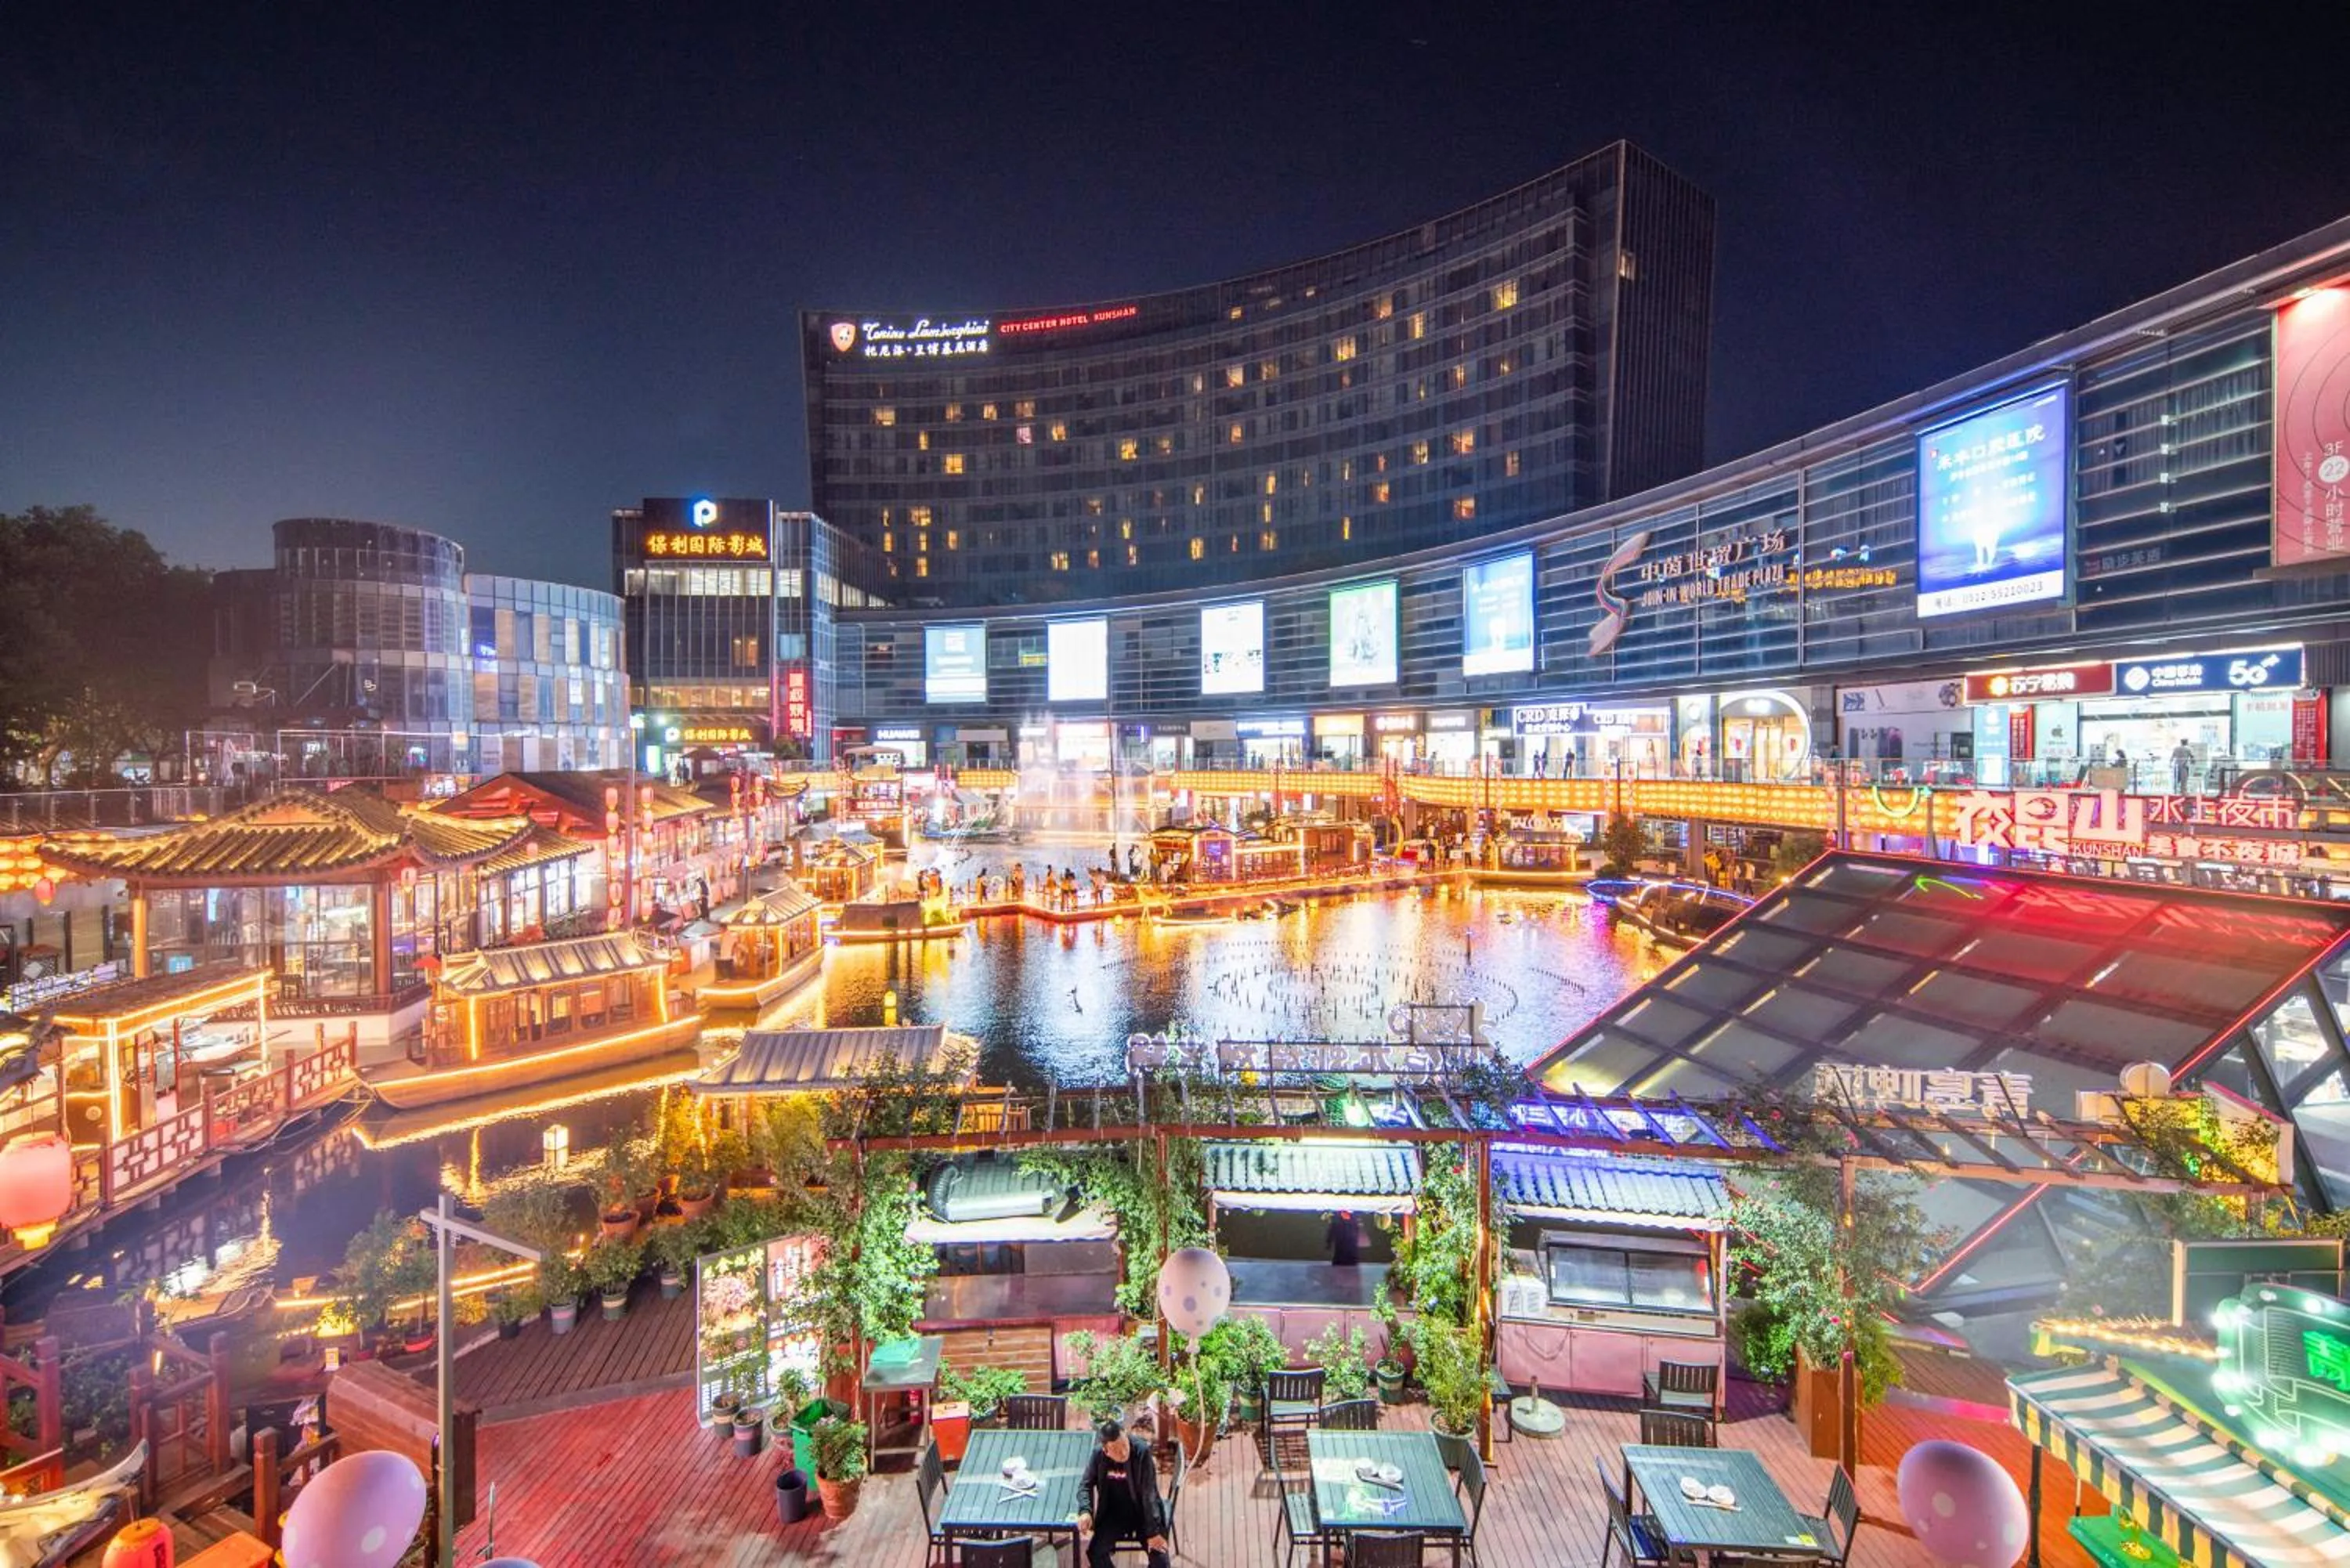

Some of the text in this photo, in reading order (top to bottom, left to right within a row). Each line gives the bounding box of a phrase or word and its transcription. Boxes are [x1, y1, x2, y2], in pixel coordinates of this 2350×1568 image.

[1000, 306, 1137, 333] CITY CENTER HOTEL KUNSHAN
[2324, 440, 2345, 457] 3F
[647, 533, 767, 557] 保利国际影城
[1679, 577, 1715, 602] WORLD
[1718, 568, 1751, 595] TRADE
[1752, 563, 1784, 586] PLAZA
[1517, 708, 1545, 723] CRD
[2148, 793, 2295, 829] 水上夜市
[2073, 841, 2144, 858] KUNSHAN
[2147, 833, 2300, 865] 美食不夜城
